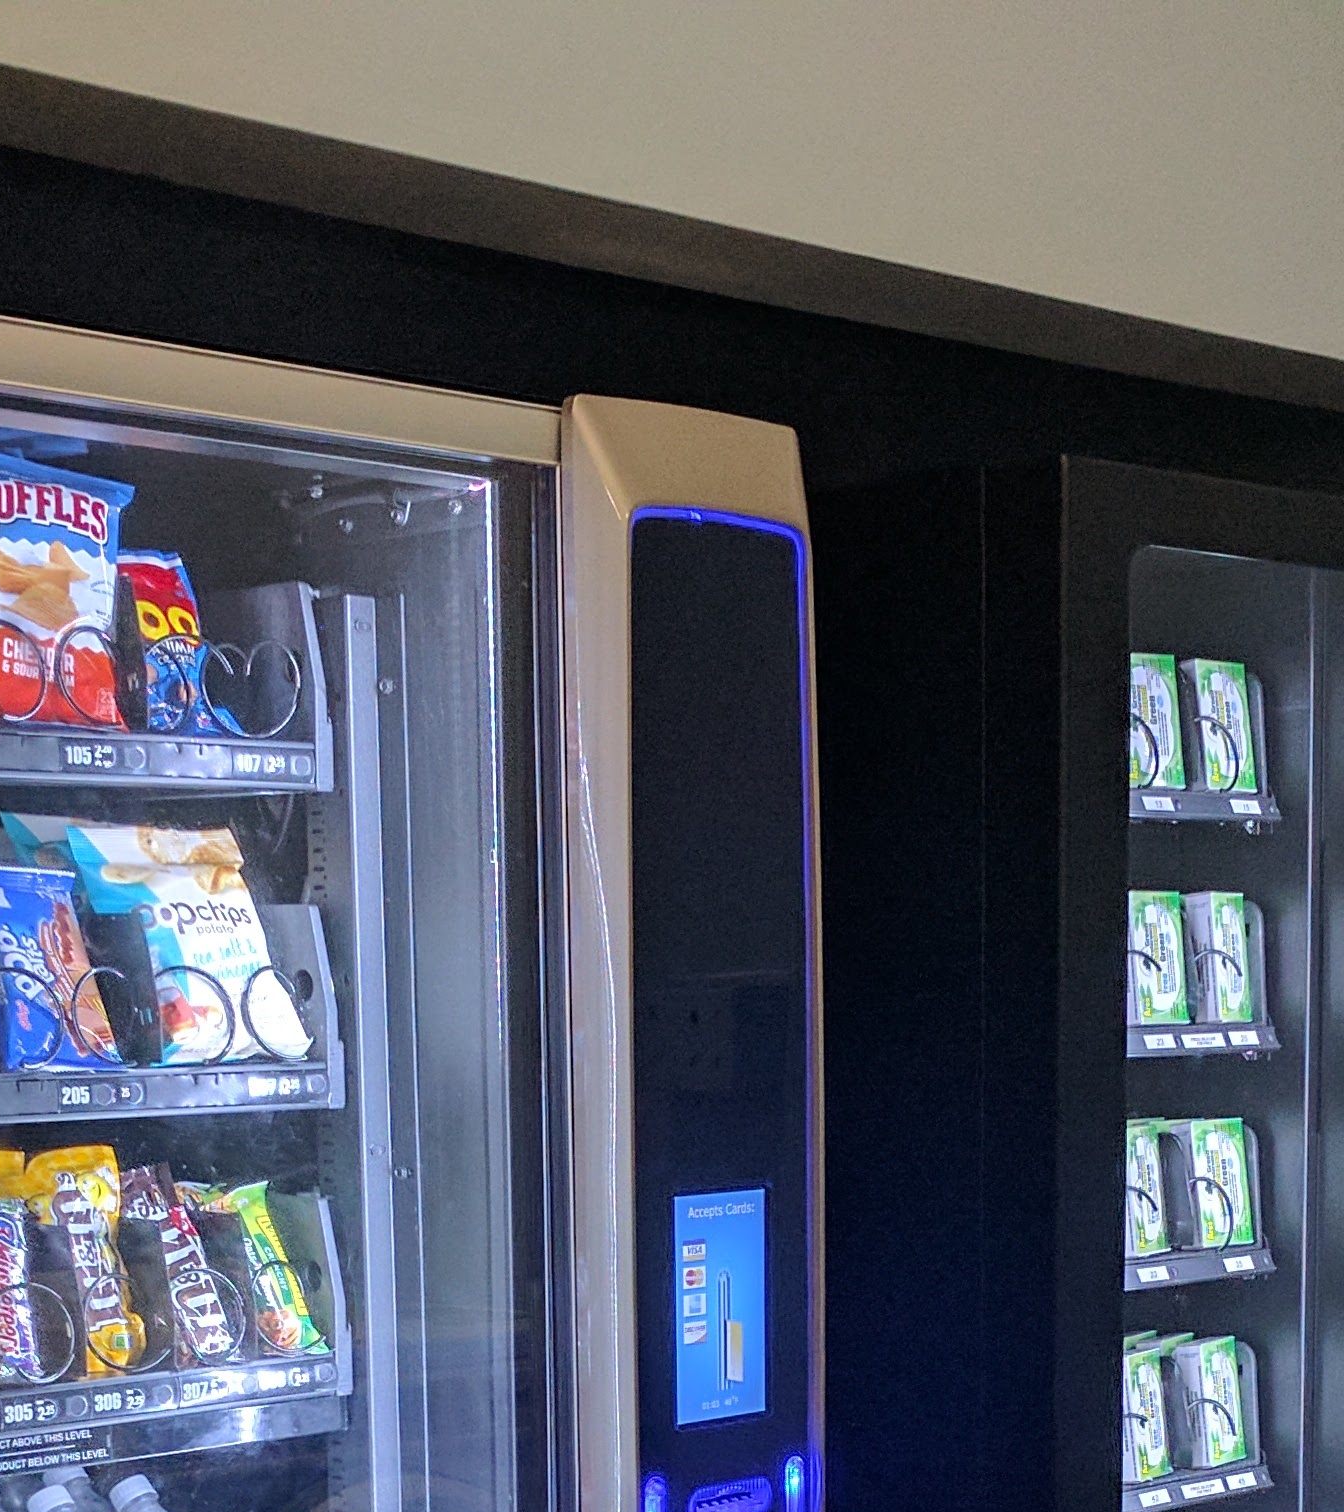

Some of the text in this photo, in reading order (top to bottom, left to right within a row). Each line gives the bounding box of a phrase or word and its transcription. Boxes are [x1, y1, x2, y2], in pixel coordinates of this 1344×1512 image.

[65, 745, 92, 765] 105
[237, 754, 261, 773] 107
[62, 1086, 90, 1105] 205
[687, 1202, 755, 1219] Accepts Cards:
[687, 1245, 703, 1255] VISA
[183, 1381, 209, 1401] 307
[94, 1391, 122, 1411] 306
[4, 1404, 33, 1423] 305
[12, 1435, 42, 1448] ABOVE
[44, 1432, 64, 1443] THIS
[65, 1429, 93, 1441] LEVEL
[28, 1454, 59, 1467] BELOW
[61, 1450, 81, 1463] THIS
[82, 1448, 110, 1460] LEVEL
